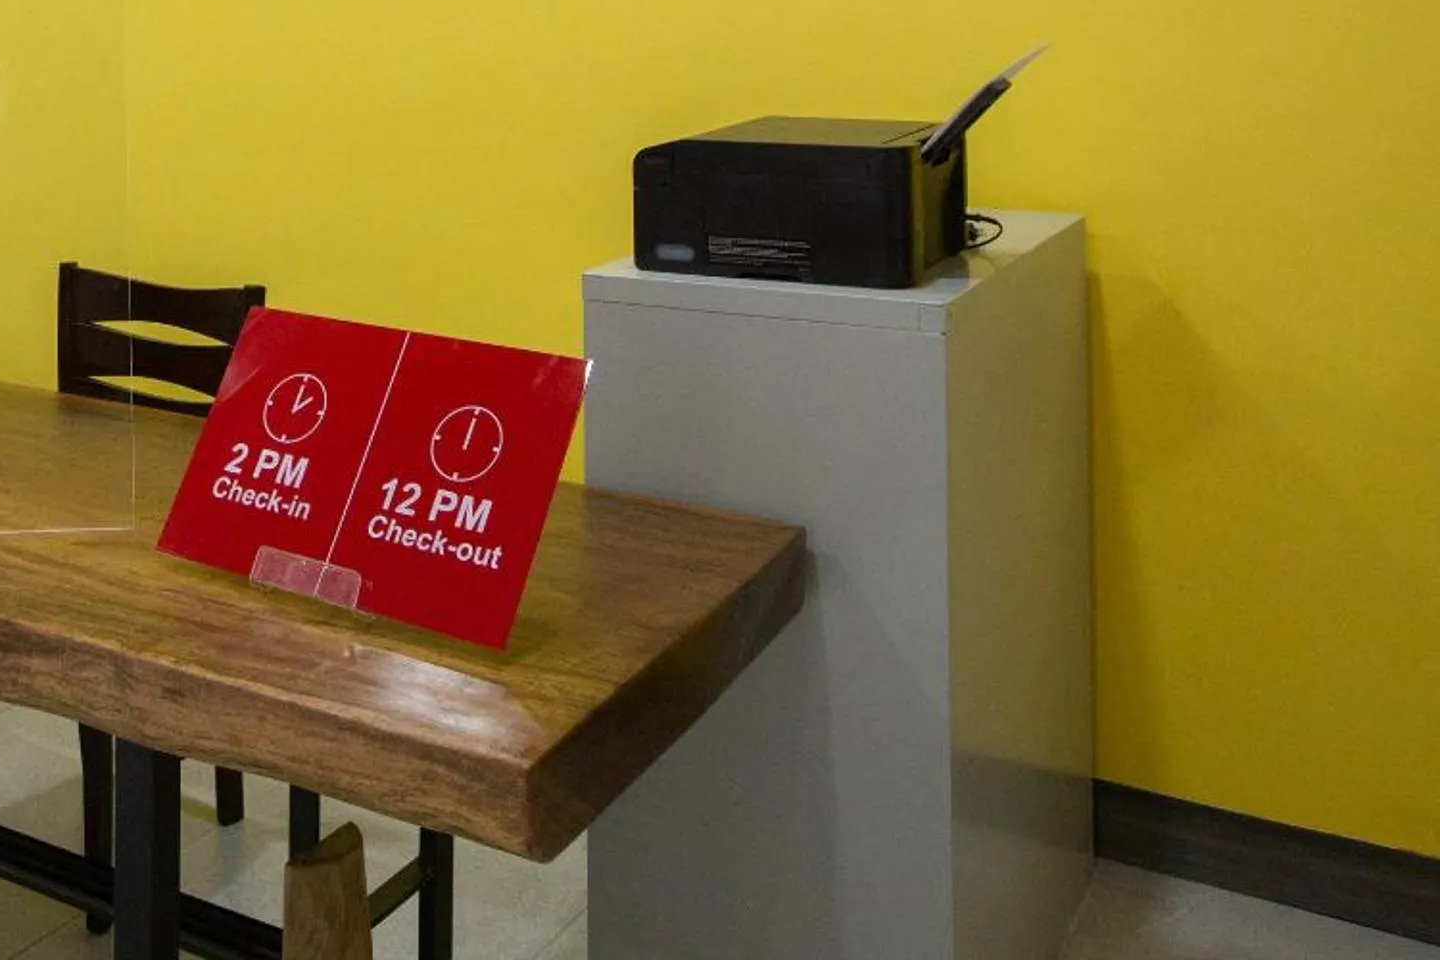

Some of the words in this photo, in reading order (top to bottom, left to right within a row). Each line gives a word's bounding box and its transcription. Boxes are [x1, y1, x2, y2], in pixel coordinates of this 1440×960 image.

[224, 443, 250, 475] 2
[252, 451, 311, 489] PM
[212, 476, 312, 521] Check-in
[380, 478, 422, 517] 12
[427, 488, 493, 534] PM
[367, 515, 503, 570] Check-out
